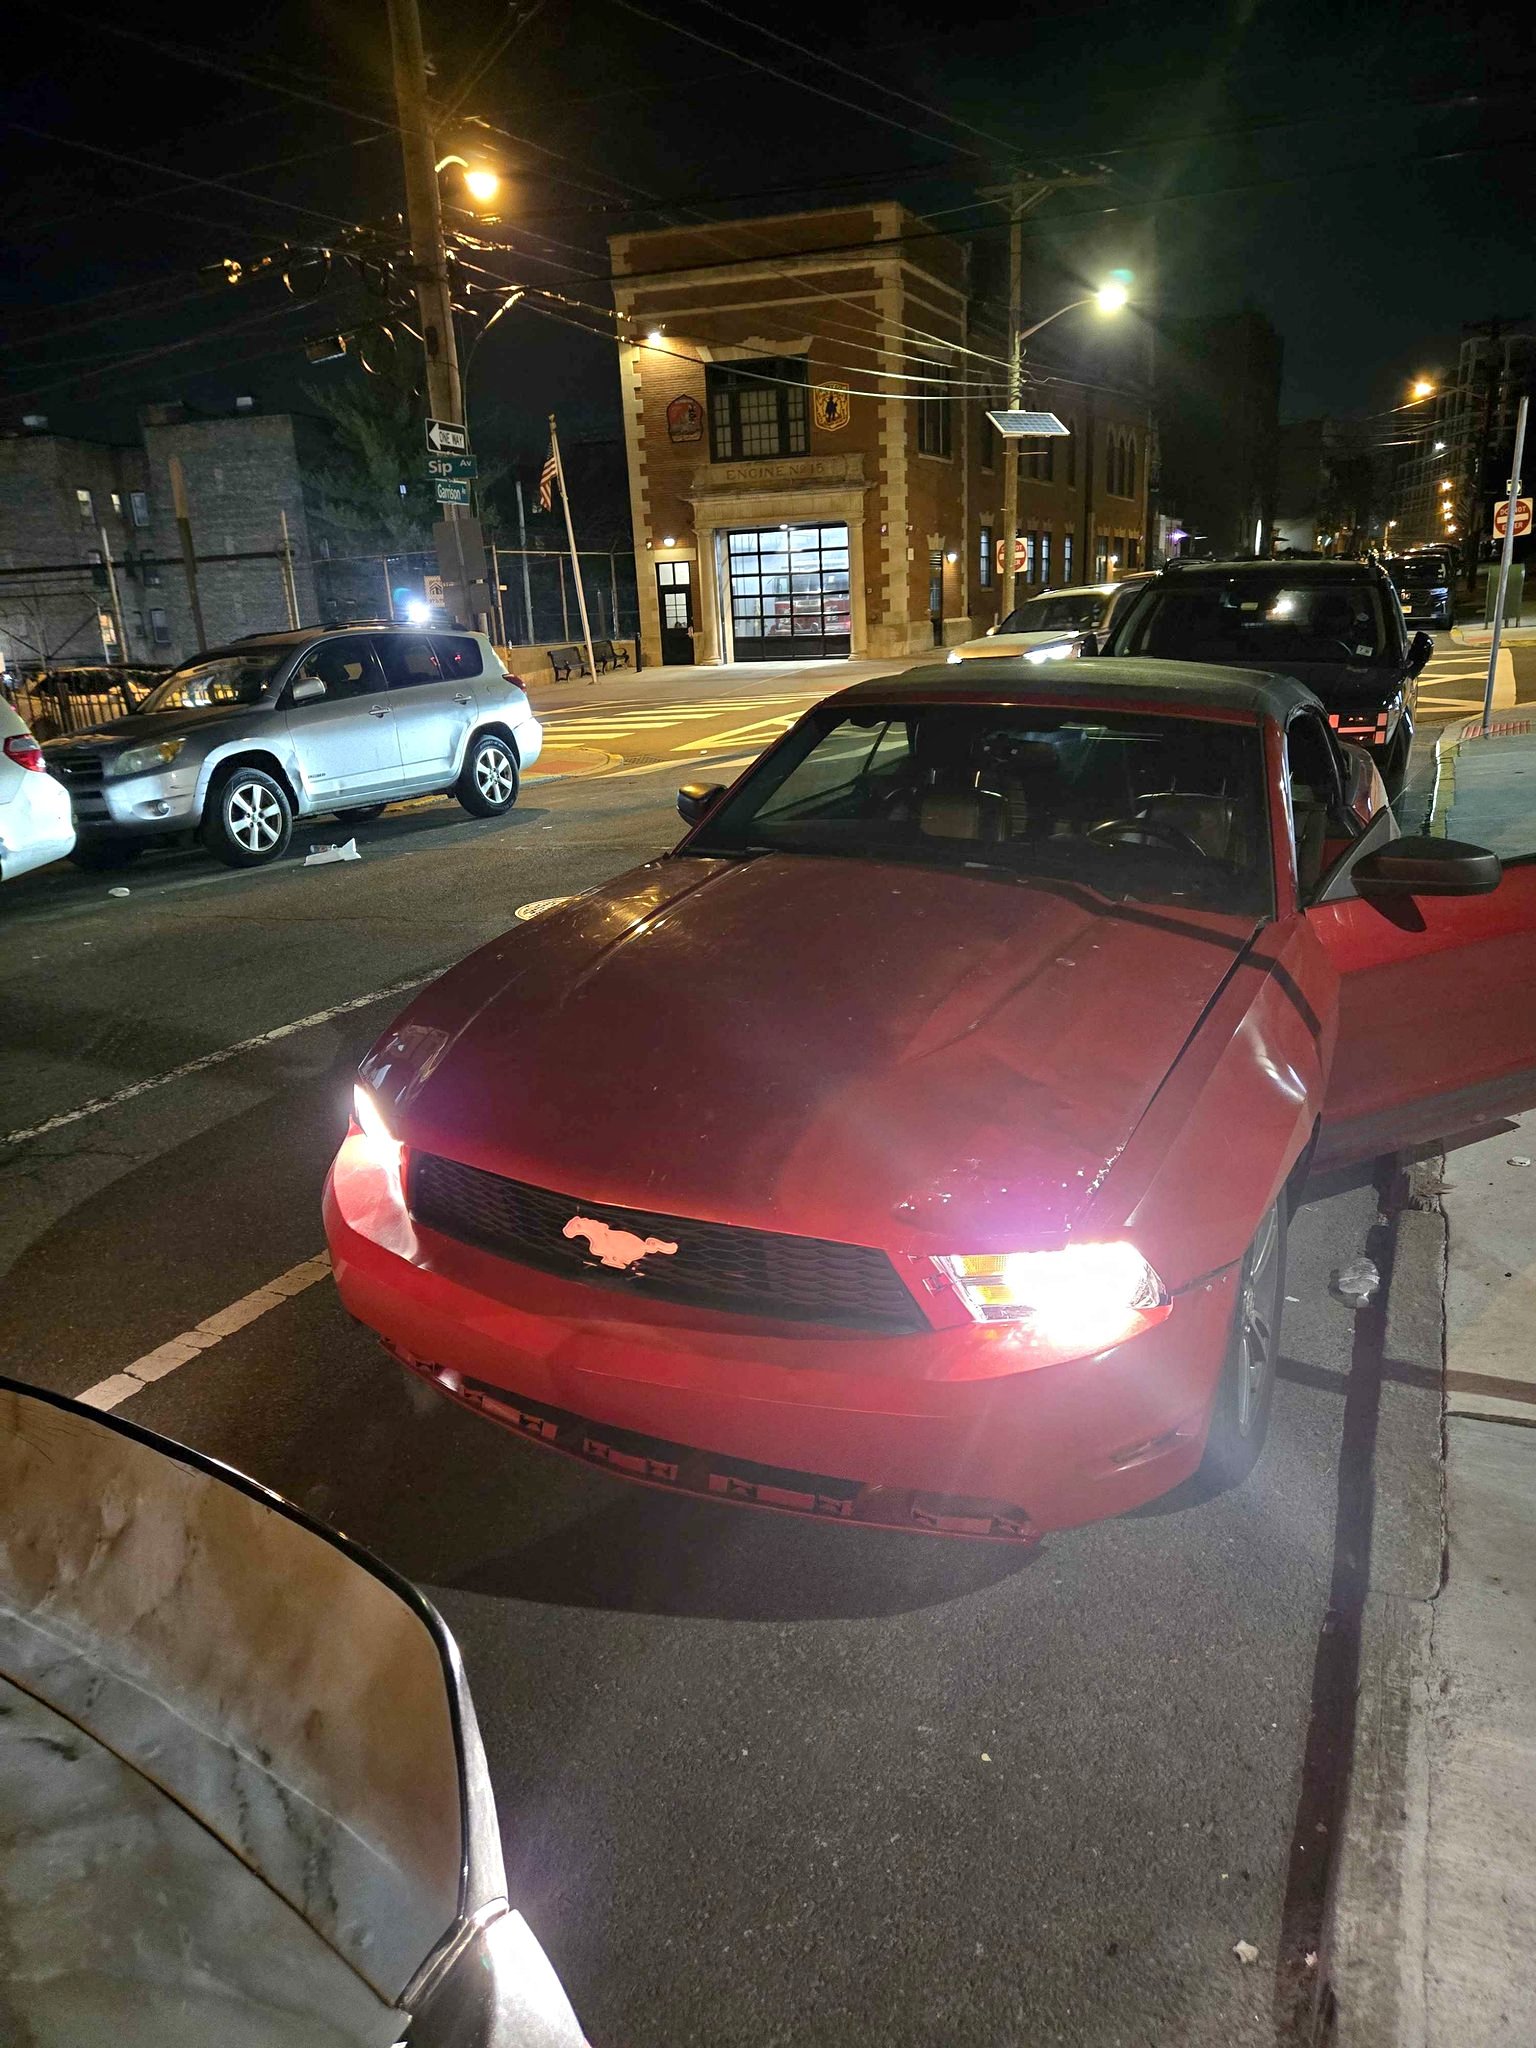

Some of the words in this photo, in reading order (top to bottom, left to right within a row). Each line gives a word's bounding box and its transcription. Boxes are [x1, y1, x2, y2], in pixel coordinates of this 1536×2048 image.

[439, 431, 450, 444] ONE
[452, 434, 463, 446] WAY
[428, 460, 453, 476] Sip
[726, 466, 784, 480] ENGINE
[810, 463, 825, 474] 15
[1502, 522, 1523, 530] EER
